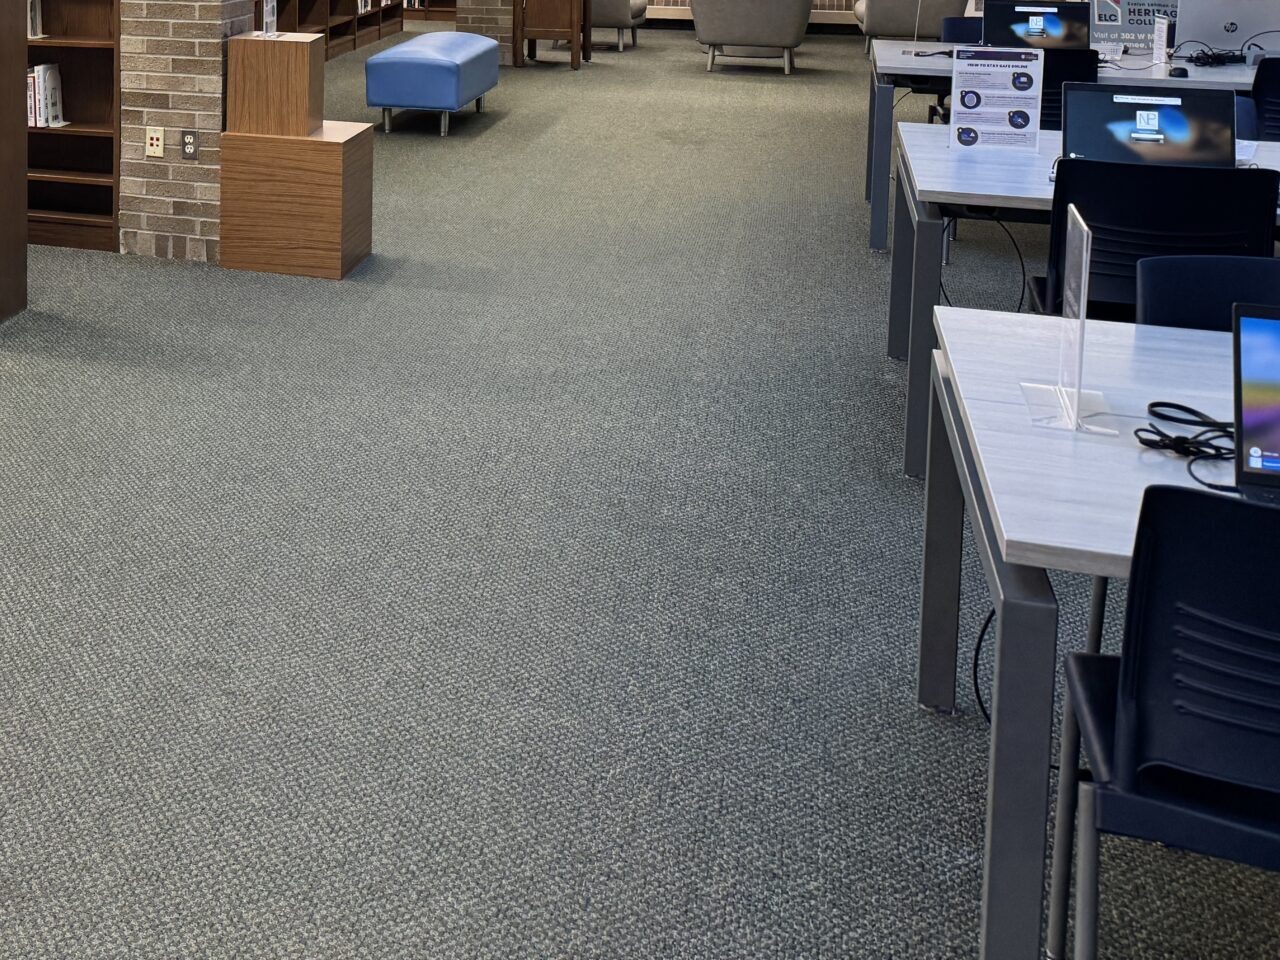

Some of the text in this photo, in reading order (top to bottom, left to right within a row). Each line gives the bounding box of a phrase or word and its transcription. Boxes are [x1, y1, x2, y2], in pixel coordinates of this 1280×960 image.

[1098, 14, 1118, 22] ELC
[1128, 8, 1178, 18] HERITAG
[1224, 22, 1238, 33] hp
